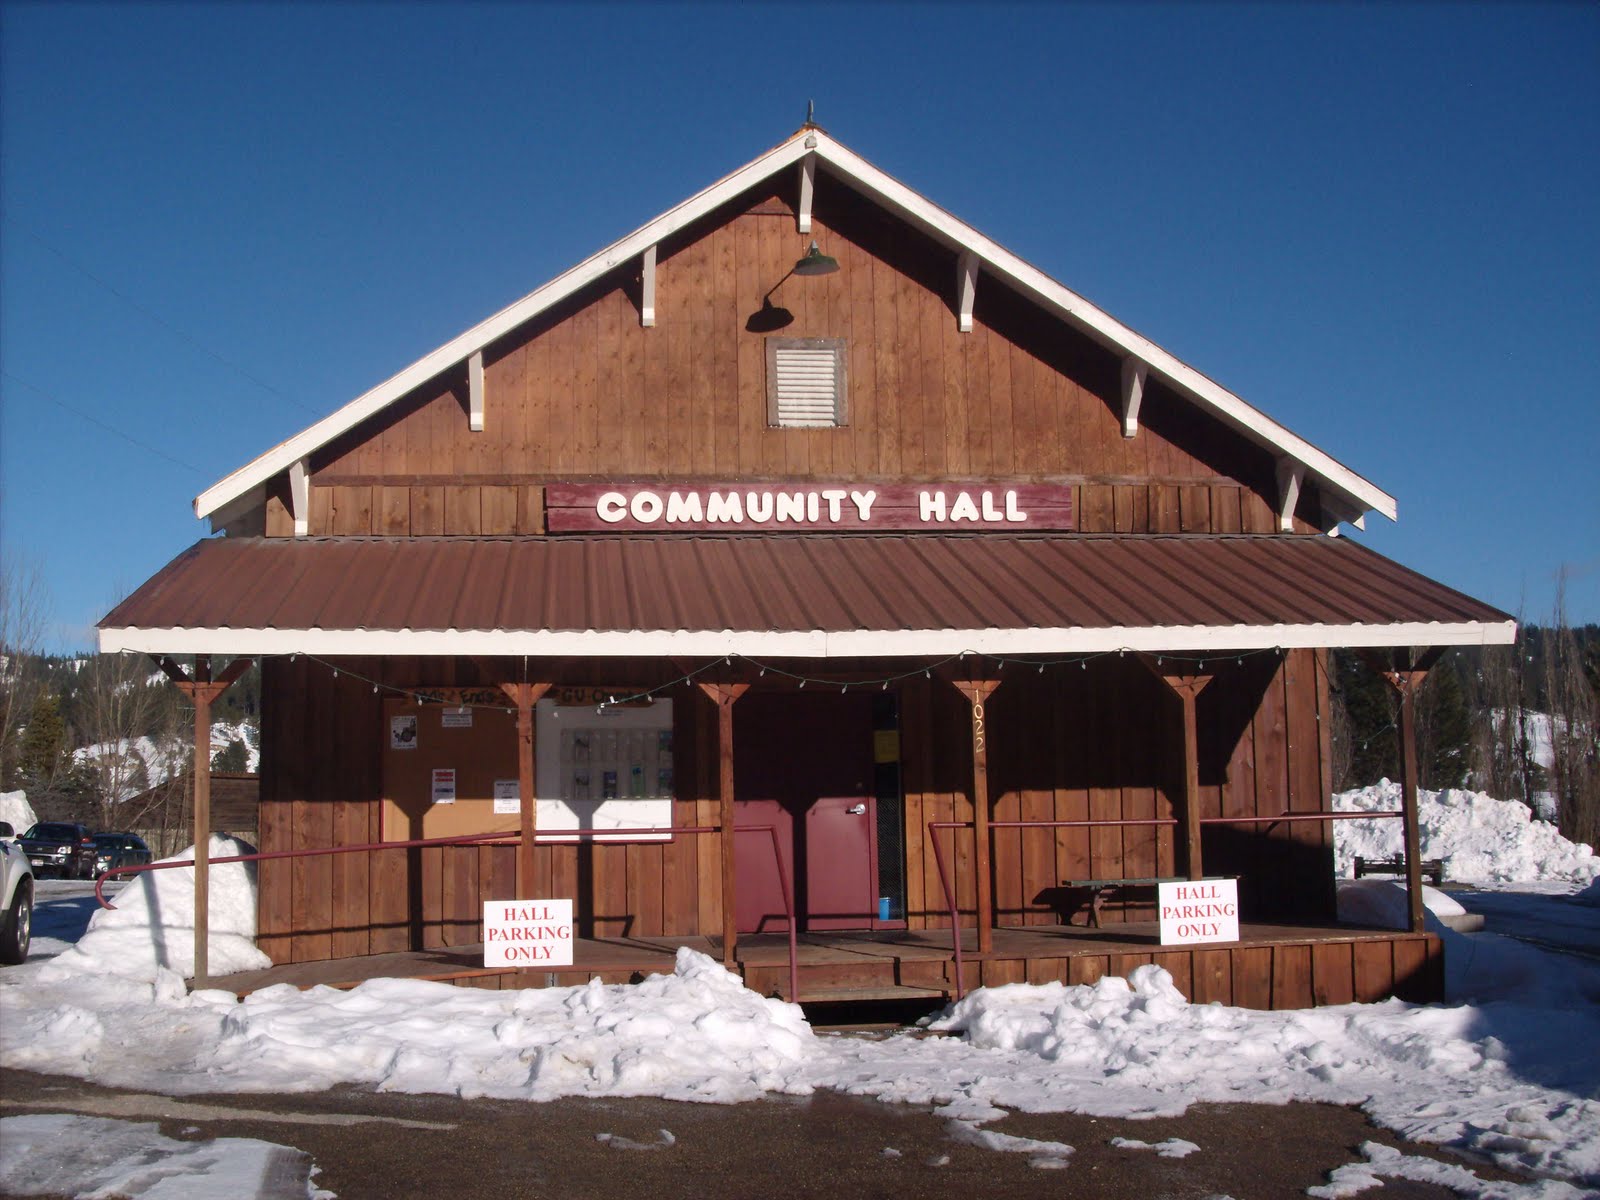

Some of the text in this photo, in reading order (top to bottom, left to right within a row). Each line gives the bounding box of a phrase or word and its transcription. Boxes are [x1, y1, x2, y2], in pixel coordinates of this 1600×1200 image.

[596, 489, 1028, 523] COMMUNITY HALL
[973, 688, 985, 753] 1022
[1176, 885, 1221, 900] HALL
[504, 907, 554, 921] HALL
[1162, 903, 1235, 919] PARKING
[488, 925, 570, 942] PARKING
[1177, 922, 1221, 938] ONLY
[504, 945, 554, 961] ONLY
